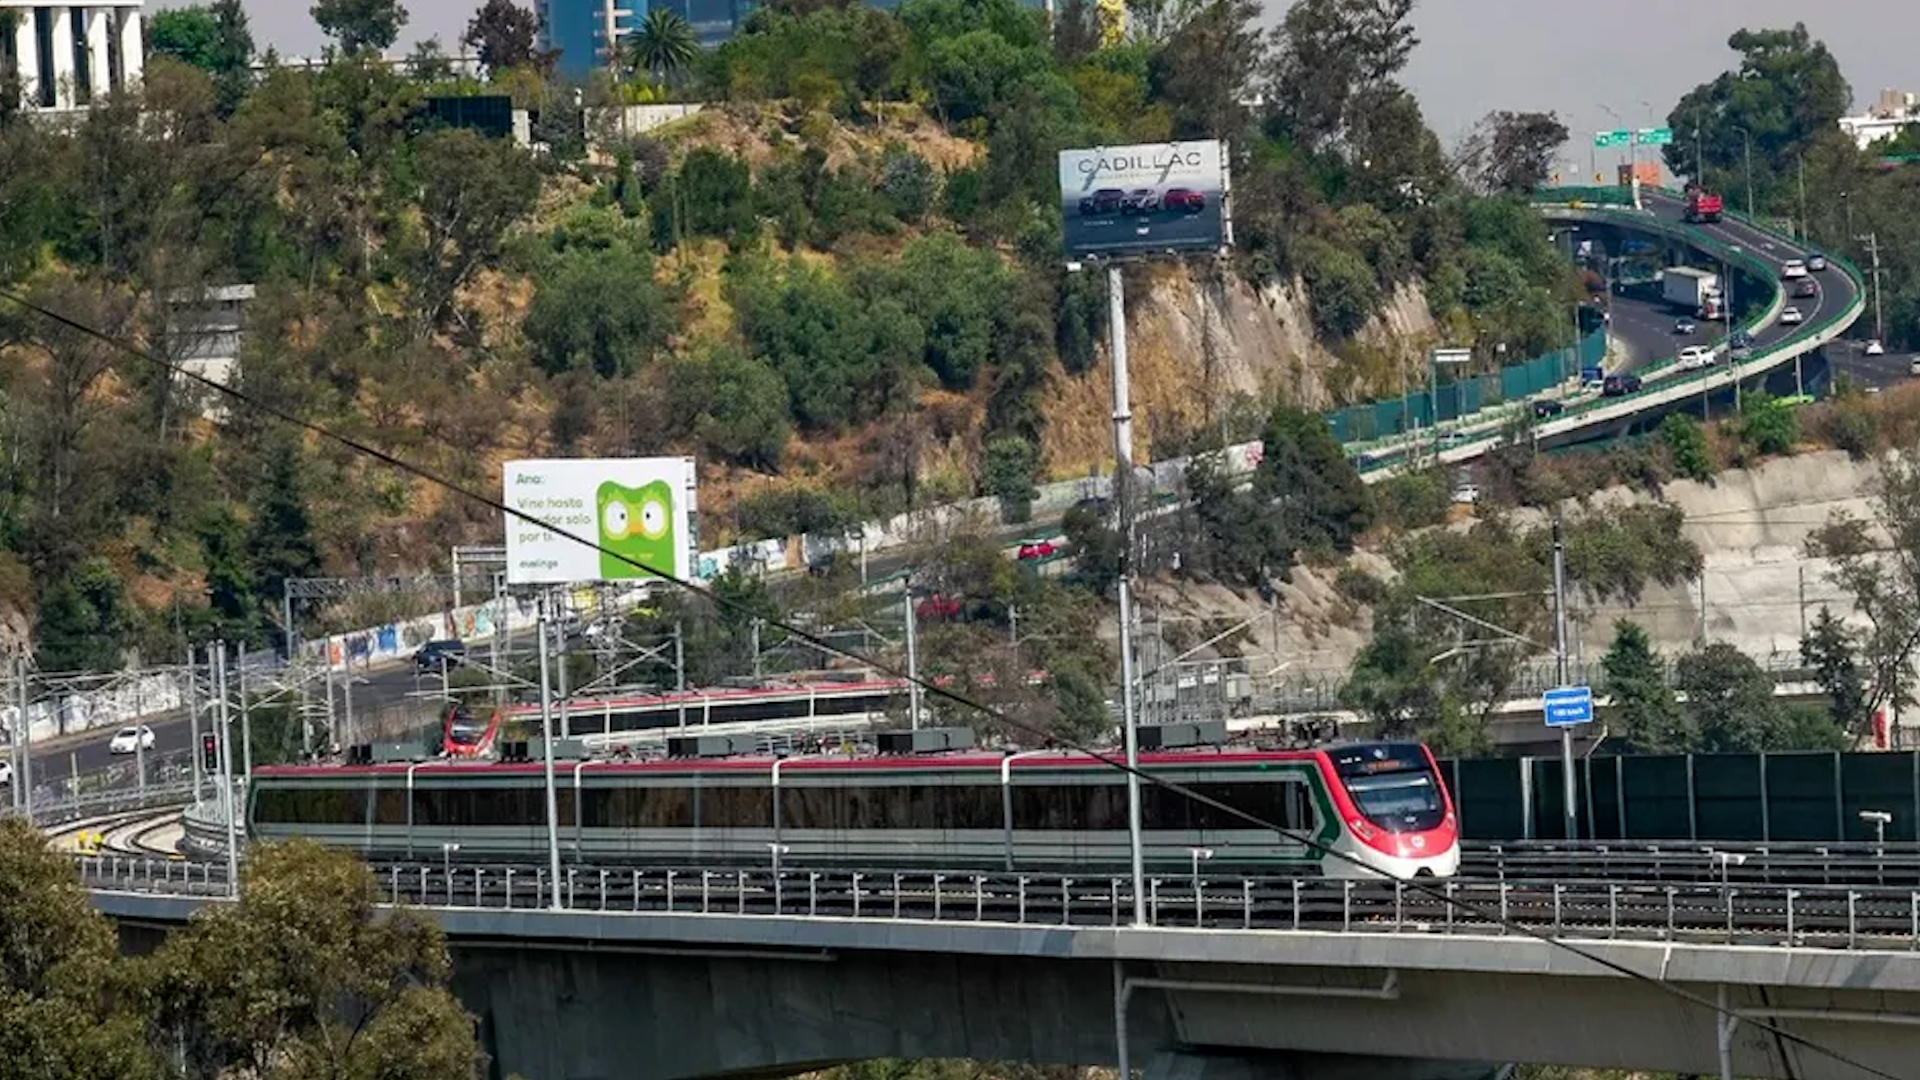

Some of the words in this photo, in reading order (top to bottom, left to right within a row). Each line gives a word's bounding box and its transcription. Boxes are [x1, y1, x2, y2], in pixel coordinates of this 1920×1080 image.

[1078, 152, 1201, 173] CADILLAC
[547, 498, 583, 508] hasta
[566, 515, 591, 525] solo
[519, 532, 541, 543] por
